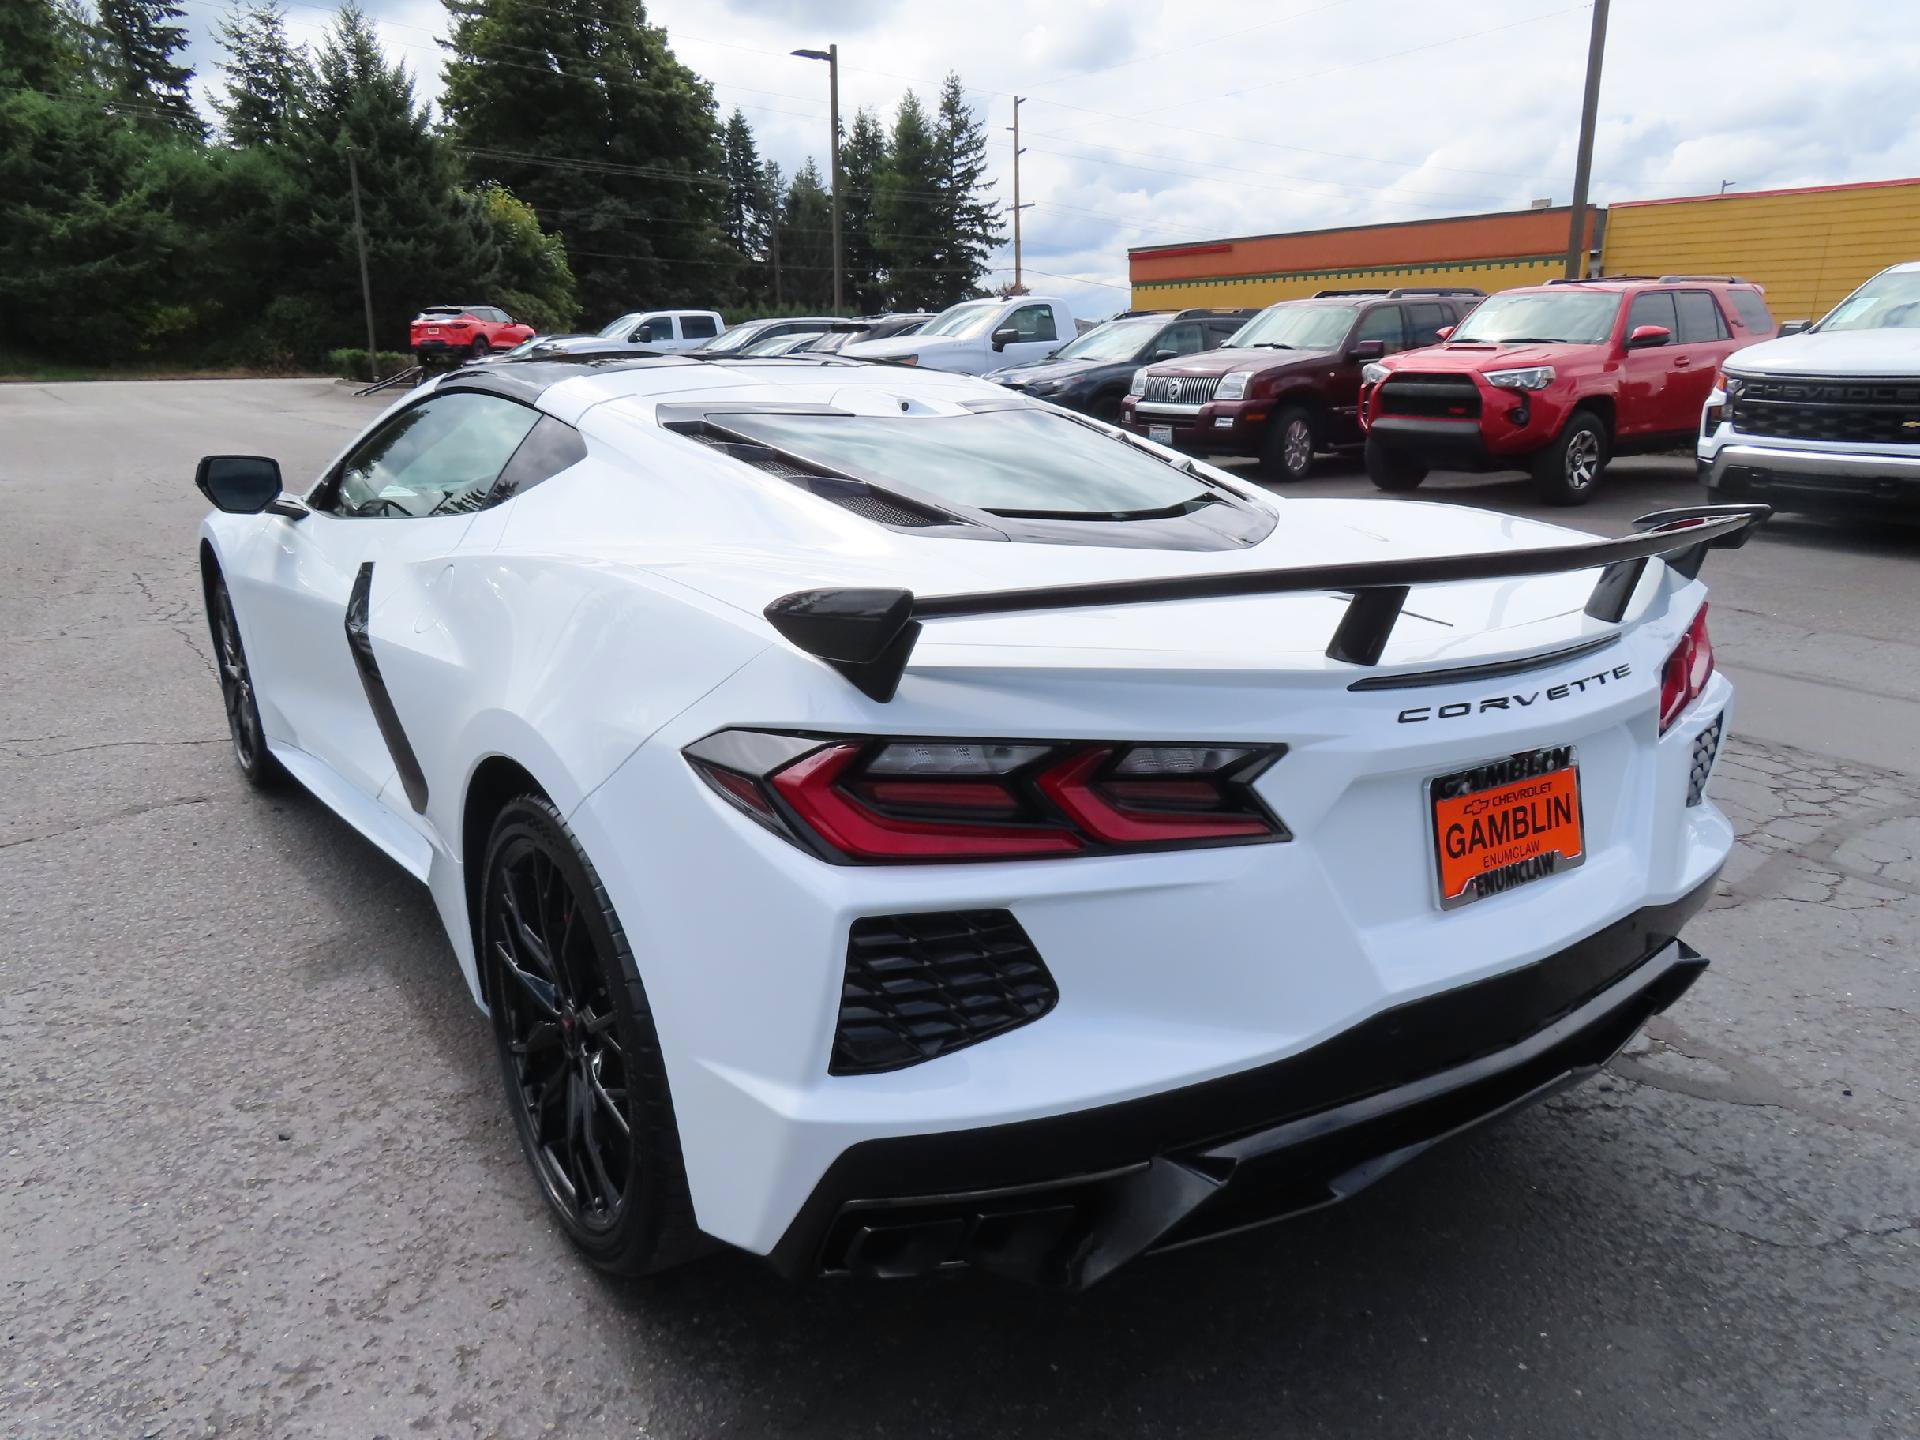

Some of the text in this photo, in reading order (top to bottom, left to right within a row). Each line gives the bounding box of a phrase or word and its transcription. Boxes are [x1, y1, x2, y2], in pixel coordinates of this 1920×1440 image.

[1398, 663, 1632, 723] CORVETTE
[1492, 781, 1553, 808] CHEVROLET
[1445, 793, 1572, 860] GAMBLIN
[1475, 851, 1555, 897] ENUMCLAW
[1482, 840, 1540, 868] ENUMCLAW
